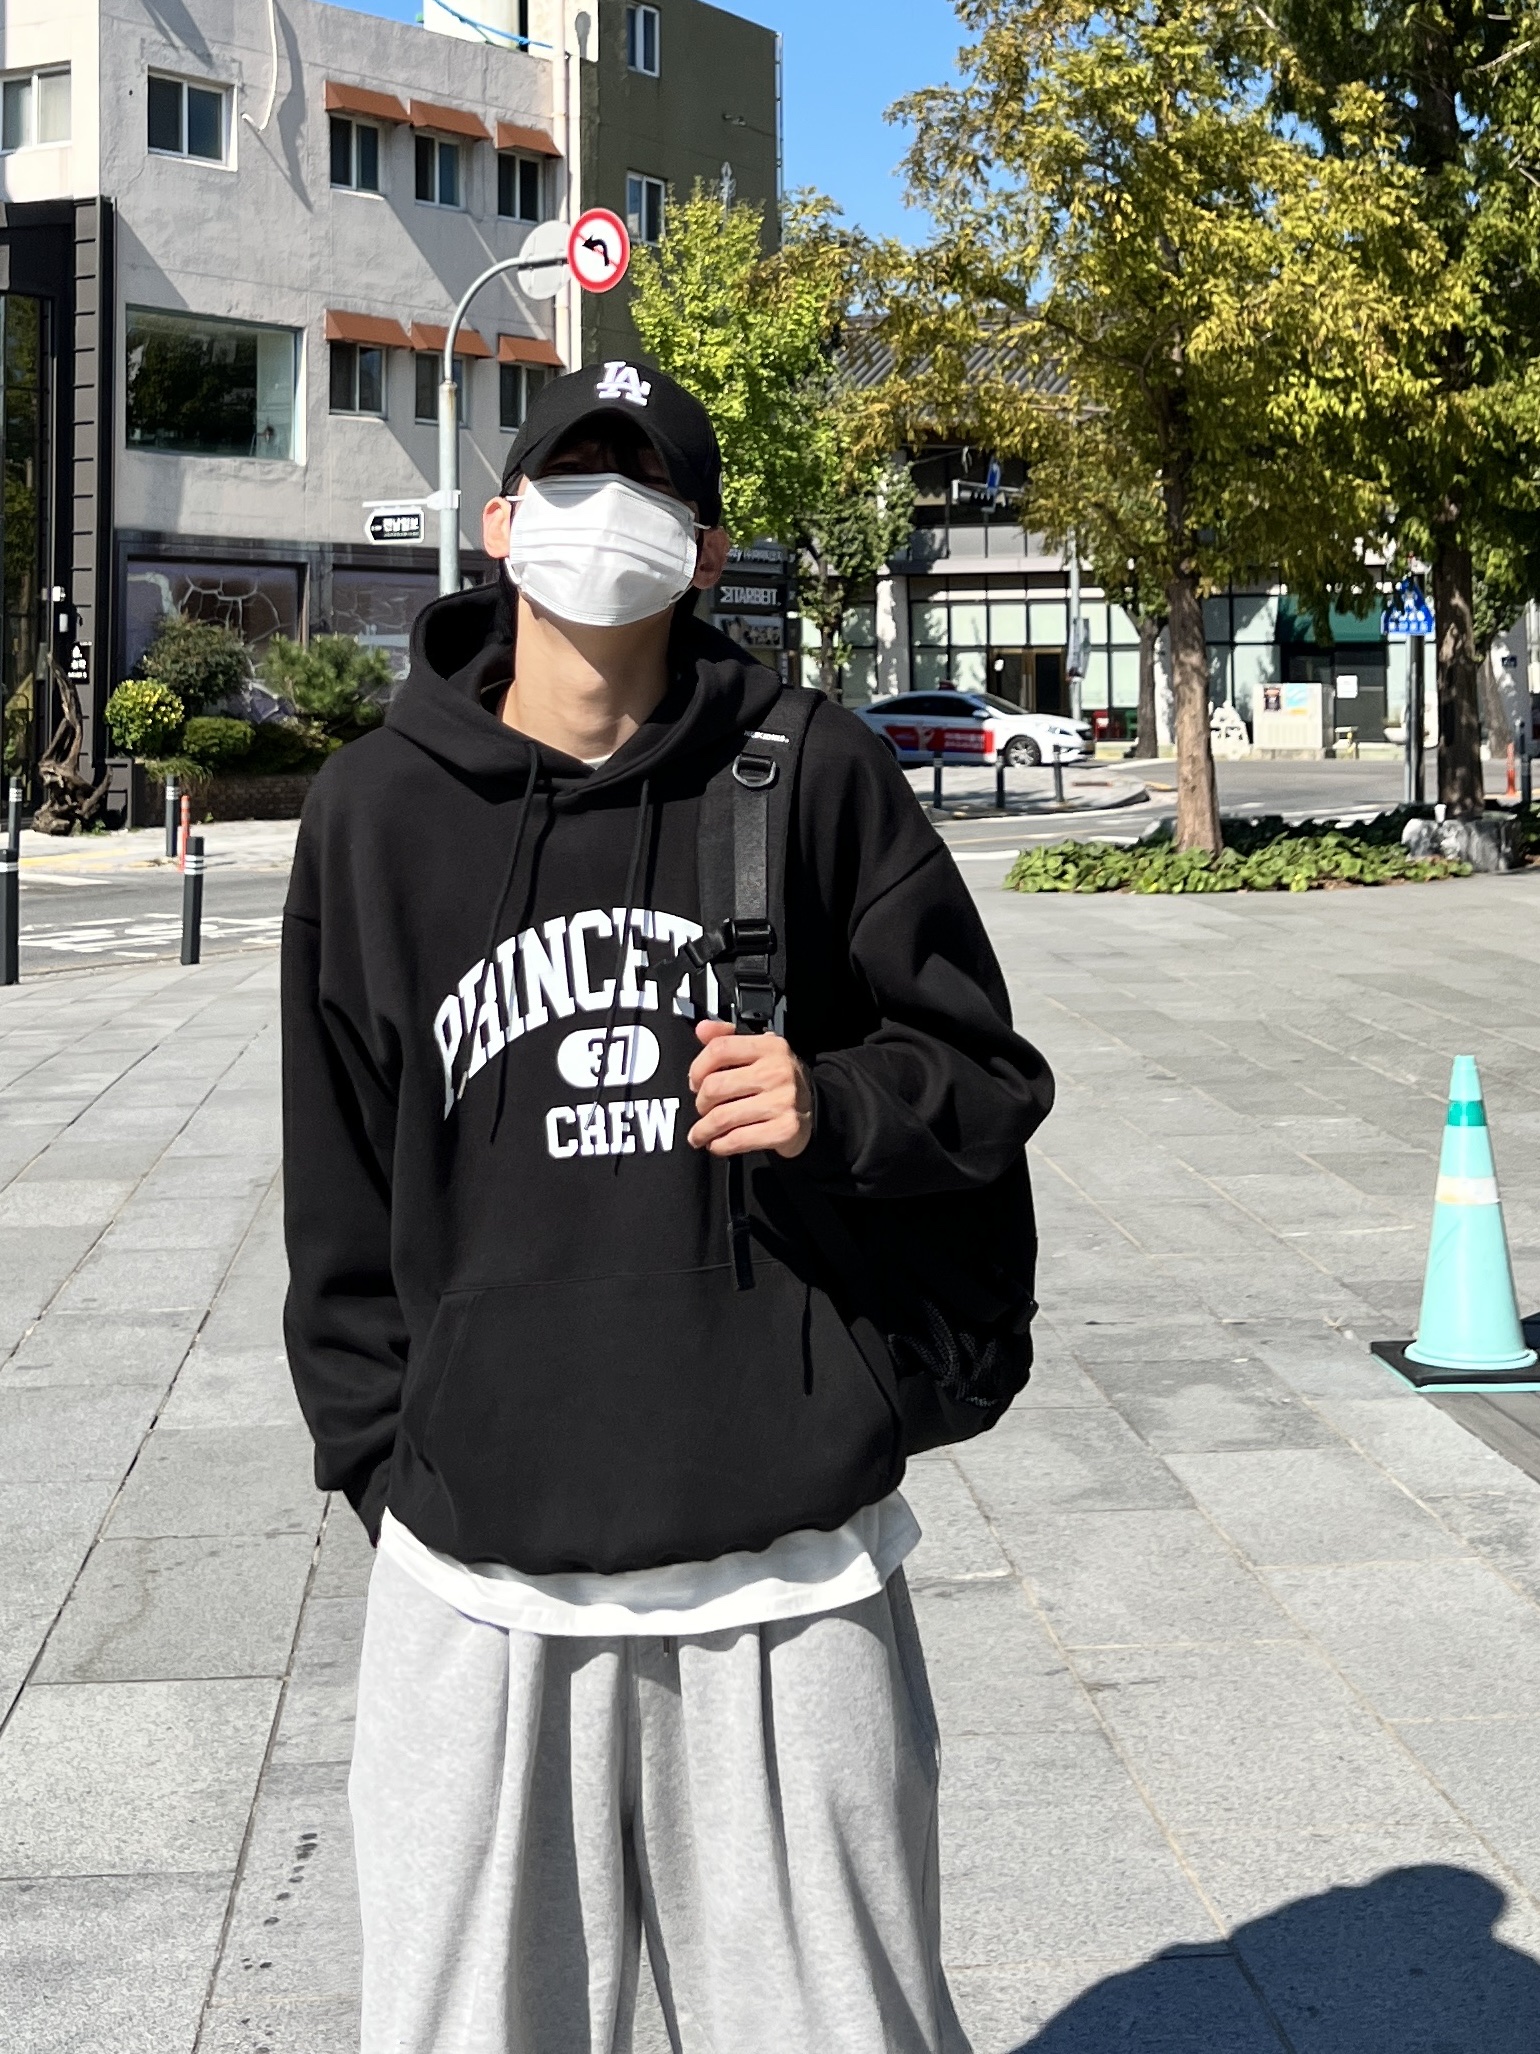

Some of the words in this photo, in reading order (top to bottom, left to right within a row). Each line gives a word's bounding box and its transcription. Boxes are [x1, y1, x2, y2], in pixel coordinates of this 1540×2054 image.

[597, 361, 651, 406] LA
[433, 907, 736, 1120] PRINCET
[588, 1035, 632, 1077] 37
[546, 1097, 680, 1159] CREW
